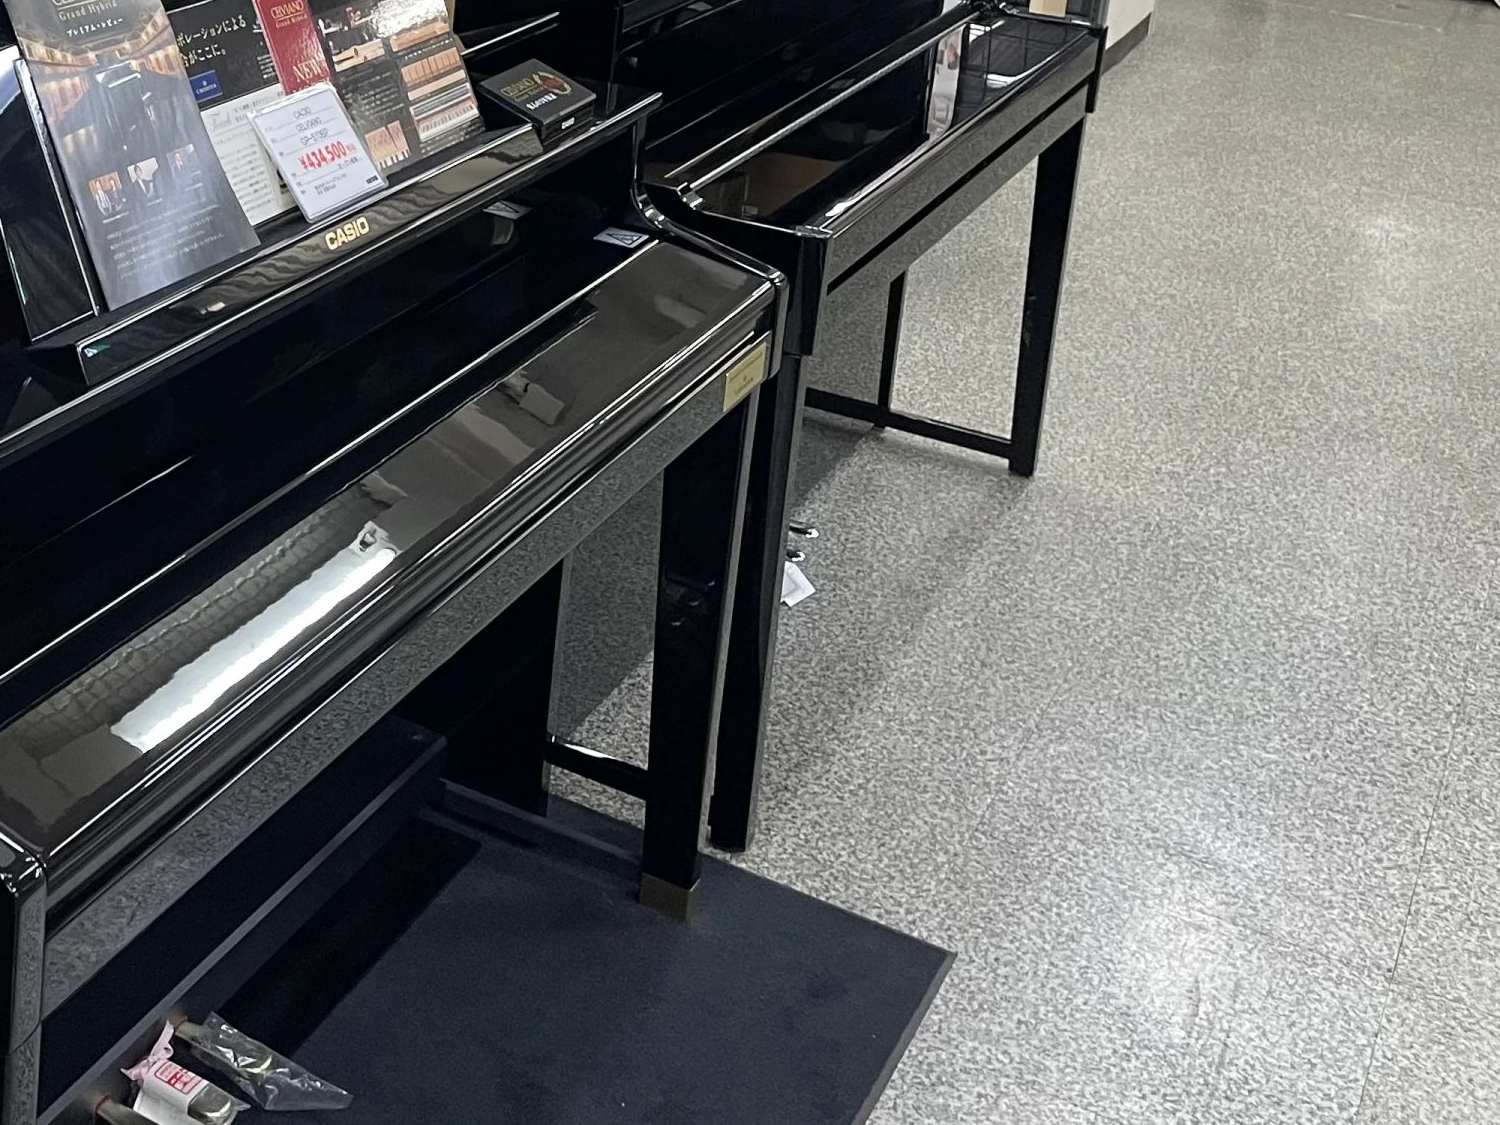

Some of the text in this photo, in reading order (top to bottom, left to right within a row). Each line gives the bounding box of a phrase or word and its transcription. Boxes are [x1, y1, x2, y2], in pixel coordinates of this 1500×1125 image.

[58, 8, 86, 21] Grand
[270, 0, 305, 20] CELVIANO
[292, 56, 324, 84] NEW
[298, 140, 347, 171] ¥434,500
[325, 216, 370, 250] CASIO
